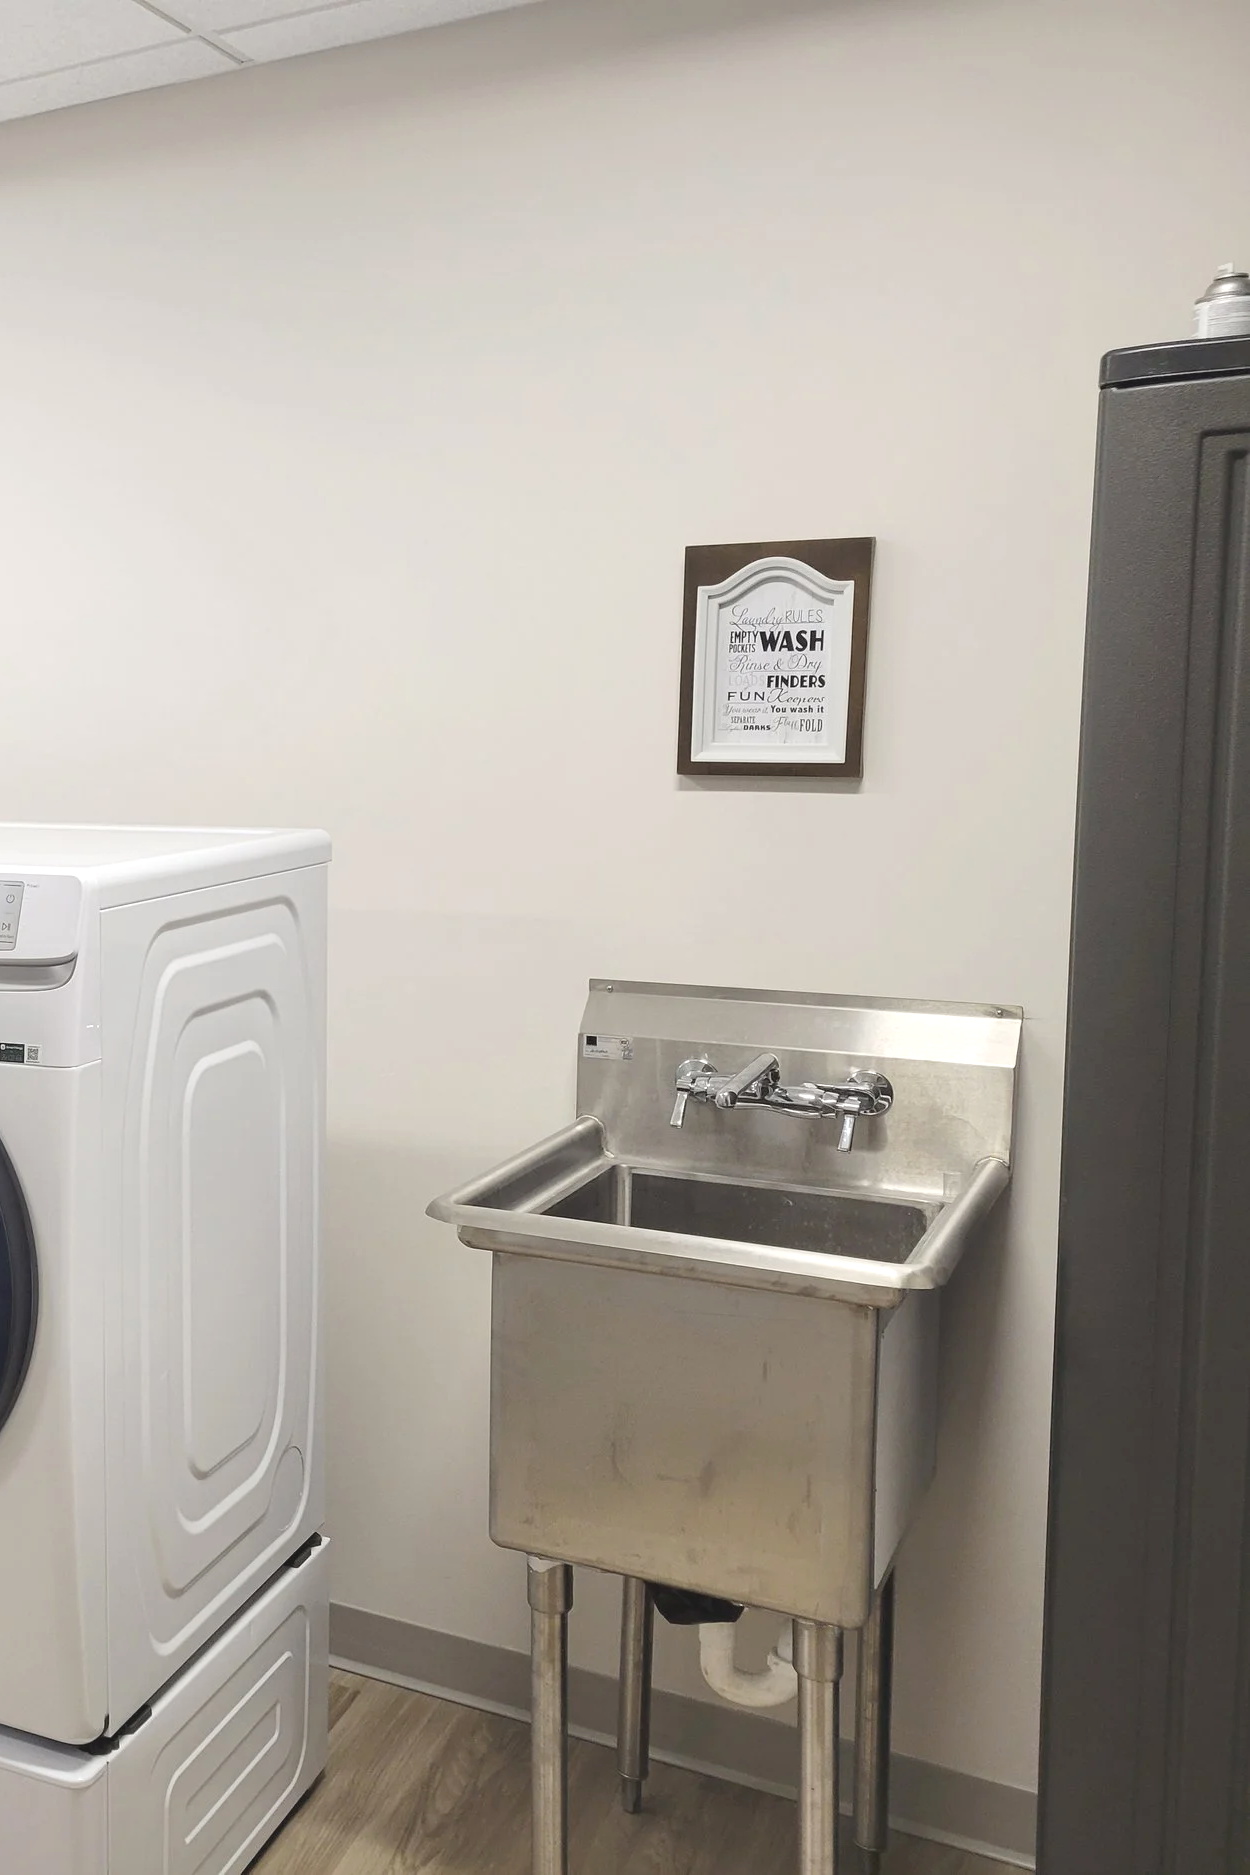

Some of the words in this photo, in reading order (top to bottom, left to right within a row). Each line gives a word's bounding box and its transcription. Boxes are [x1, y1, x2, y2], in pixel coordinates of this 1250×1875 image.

[730, 605, 783, 631] Laundry
[785, 609, 823, 623] RULES
[730, 631, 759, 643] EMPTY
[759, 630, 824, 652] WASH
[729, 644, 756, 653] POCKETS
[729, 655, 770, 674] Rinse
[773, 658, 784, 671] &
[788, 654, 822, 673] Dry
[766, 675, 826, 688] FINDERS
[727, 692, 765, 701] FUN
[767, 688, 825, 706] Keepers
[770, 705, 787, 713] You
[790, 705, 814, 713] wash
[817, 705, 824, 713] it
[730, 716, 756, 724] SEPARATE
[799, 719, 823, 732] FOLD
